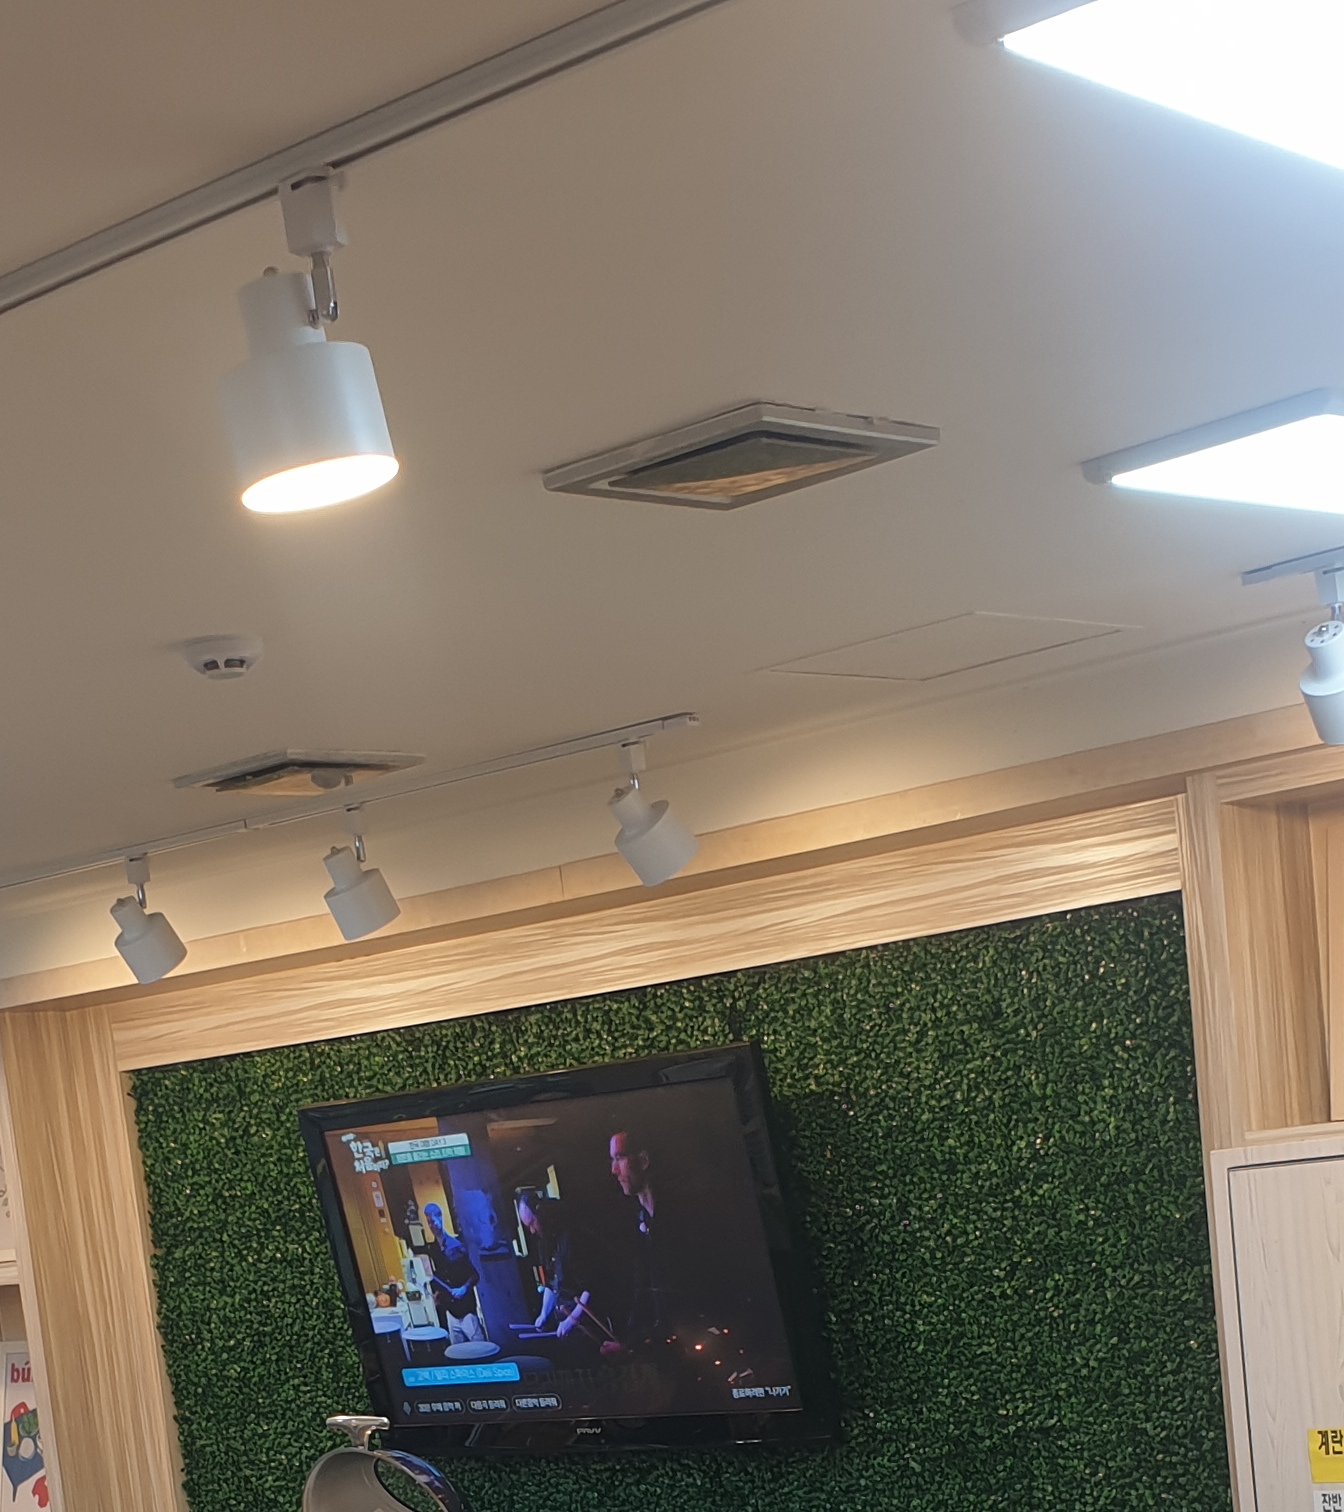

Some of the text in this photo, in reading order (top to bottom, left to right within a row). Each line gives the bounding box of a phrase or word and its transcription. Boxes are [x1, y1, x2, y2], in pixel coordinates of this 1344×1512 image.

[10, 1361, 34, 1384] bú
[1317, 1429, 1344, 1455] 계란
[1321, 1493, 1342, 1512] 잔반
